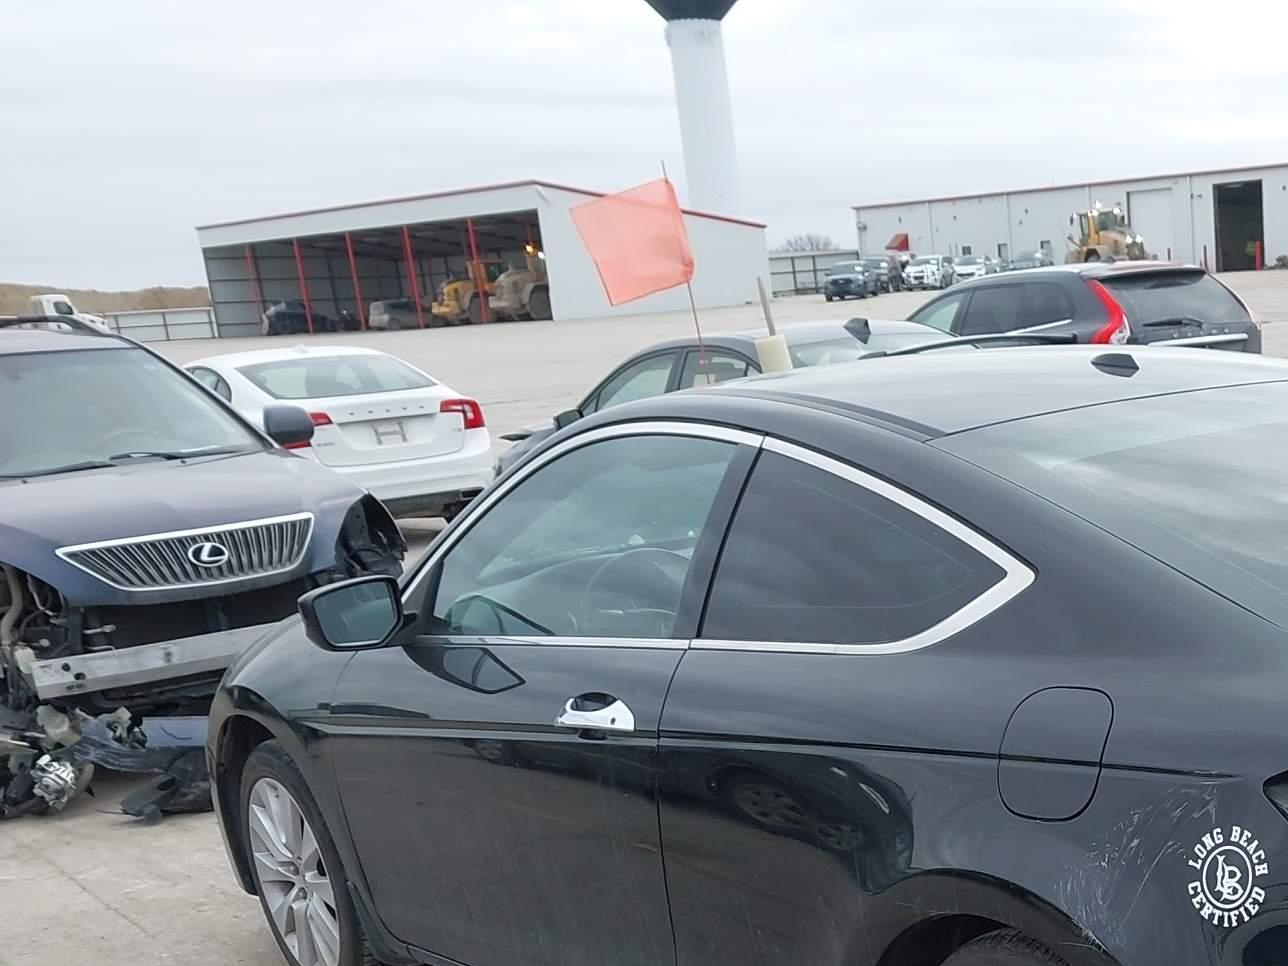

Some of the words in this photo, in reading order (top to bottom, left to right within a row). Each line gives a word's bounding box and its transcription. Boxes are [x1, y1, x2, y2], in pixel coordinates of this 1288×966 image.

[1188, 827, 1224, 870] LONG
[1230, 825, 1269, 877] BEACH
[1187, 881, 1266, 928] CERTIFIED
